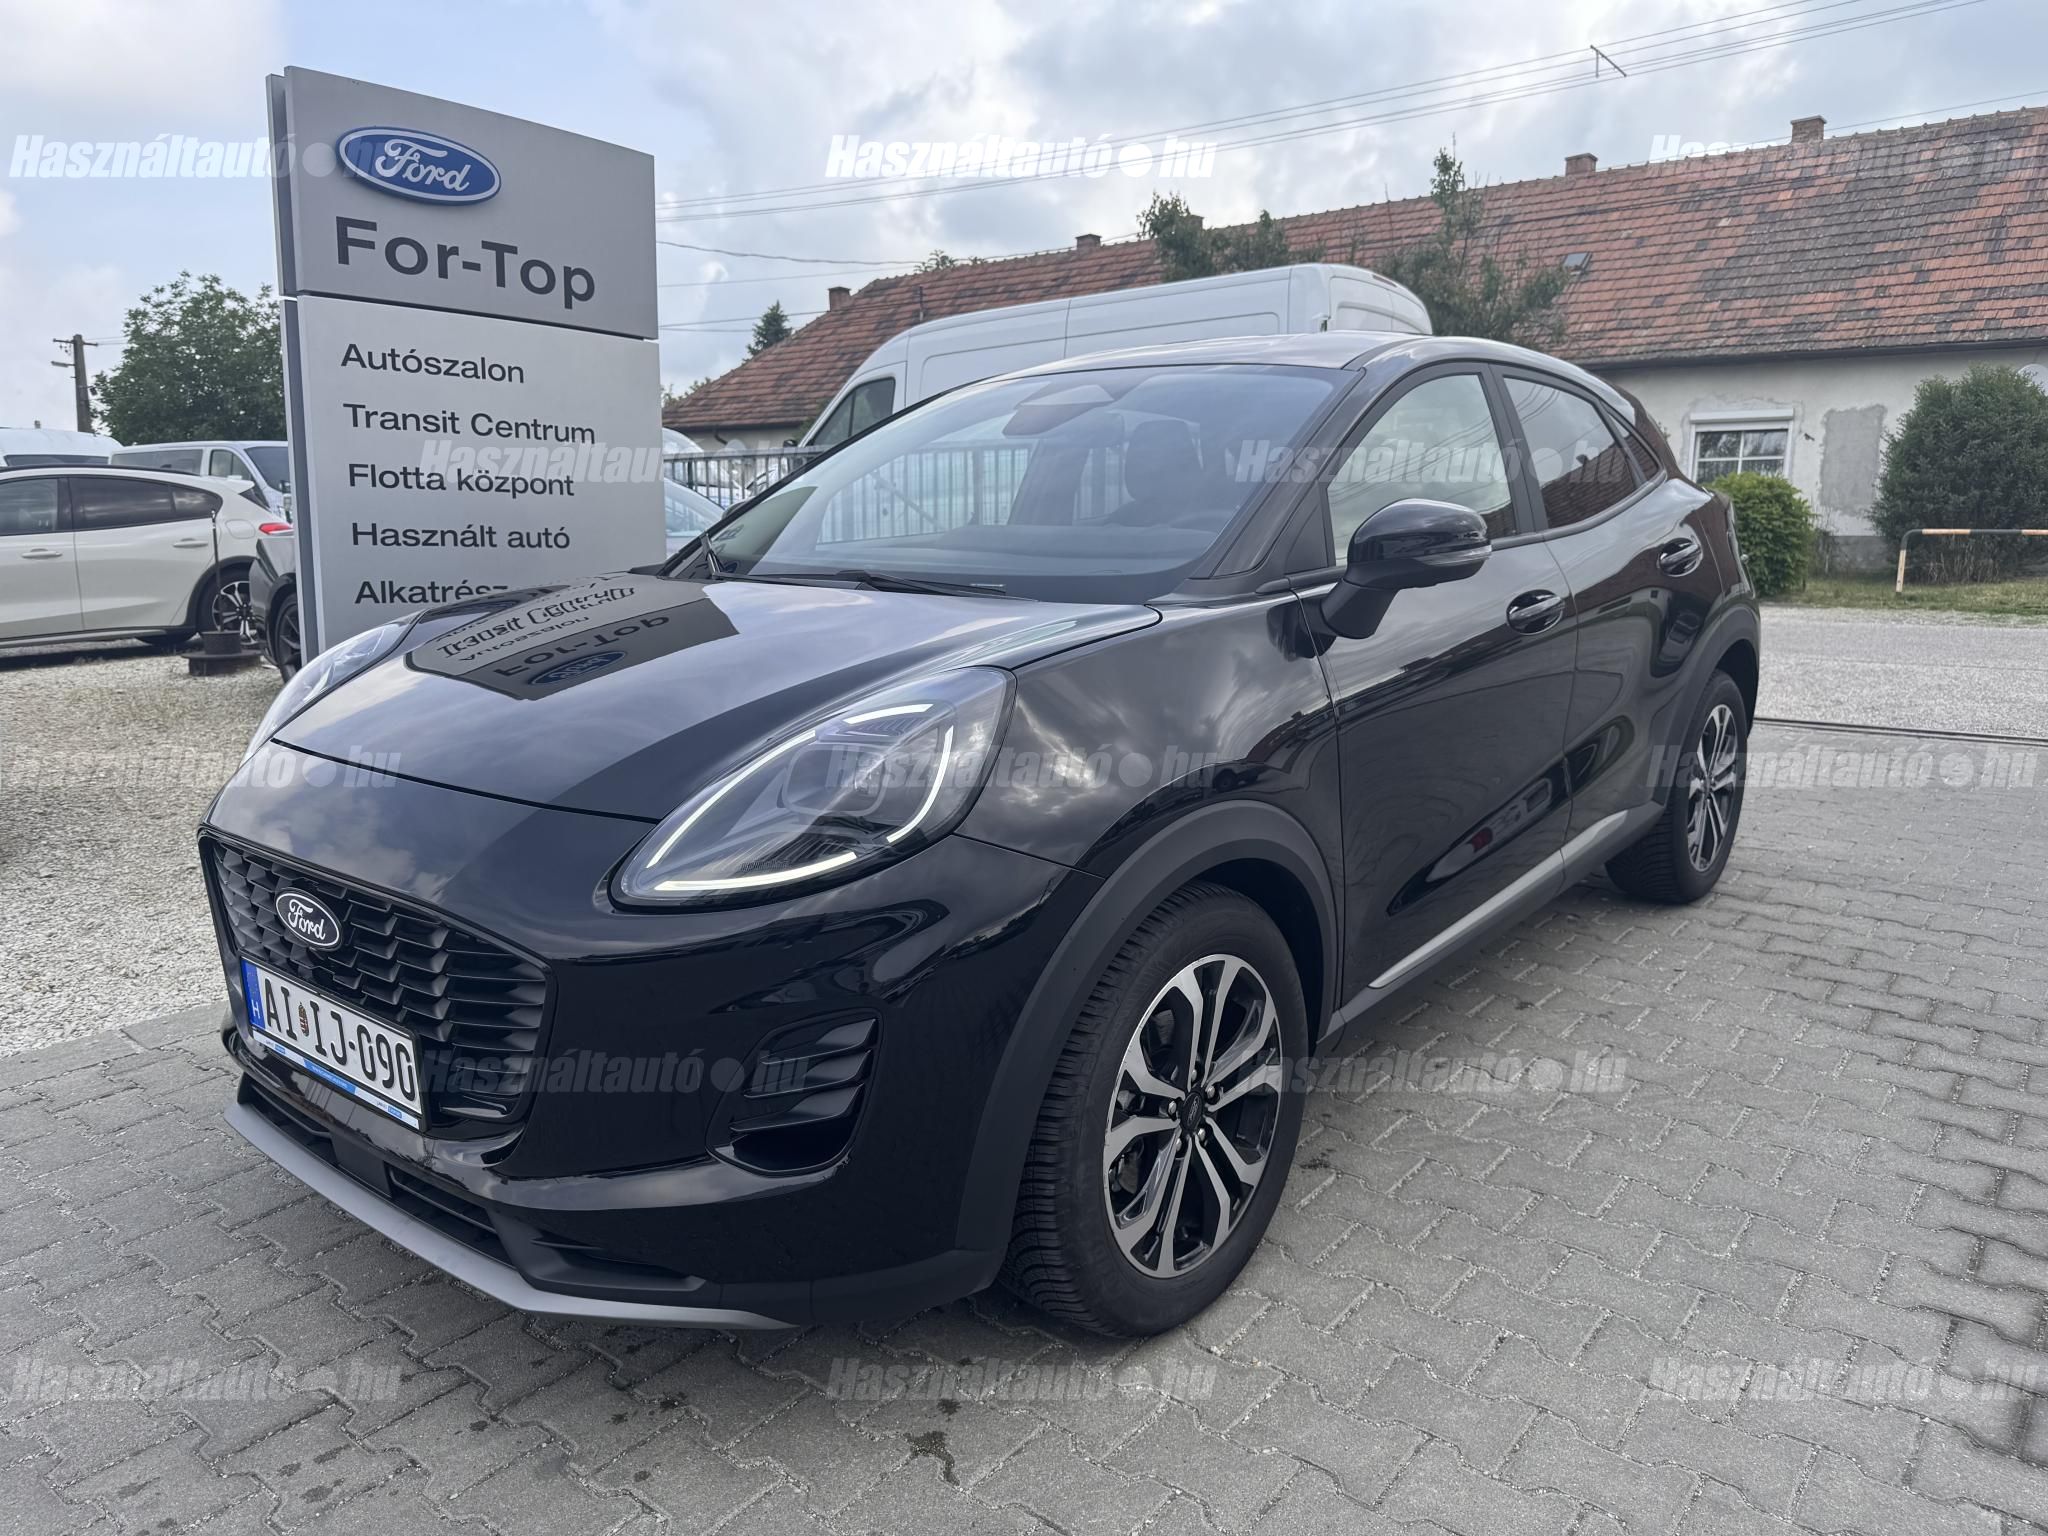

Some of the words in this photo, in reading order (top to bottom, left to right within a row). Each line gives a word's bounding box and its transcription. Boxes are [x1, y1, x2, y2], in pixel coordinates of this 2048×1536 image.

[375, 138, 472, 193] Ford
[336, 215, 595, 310] For-Top
[340, 343, 525, 384] Autószalon
[342, 402, 461, 435] Transit
[470, 412, 596, 445] Centrum
[348, 463, 447, 491] Flotta
[457, 468, 575, 500] központ
[351, 521, 498, 549] Használt
[506, 526, 571, 550] autó
[354, 579, 509, 604] Alkatrés
[288, 898, 326, 941] Ford
[251, 1000, 261, 1019] H
